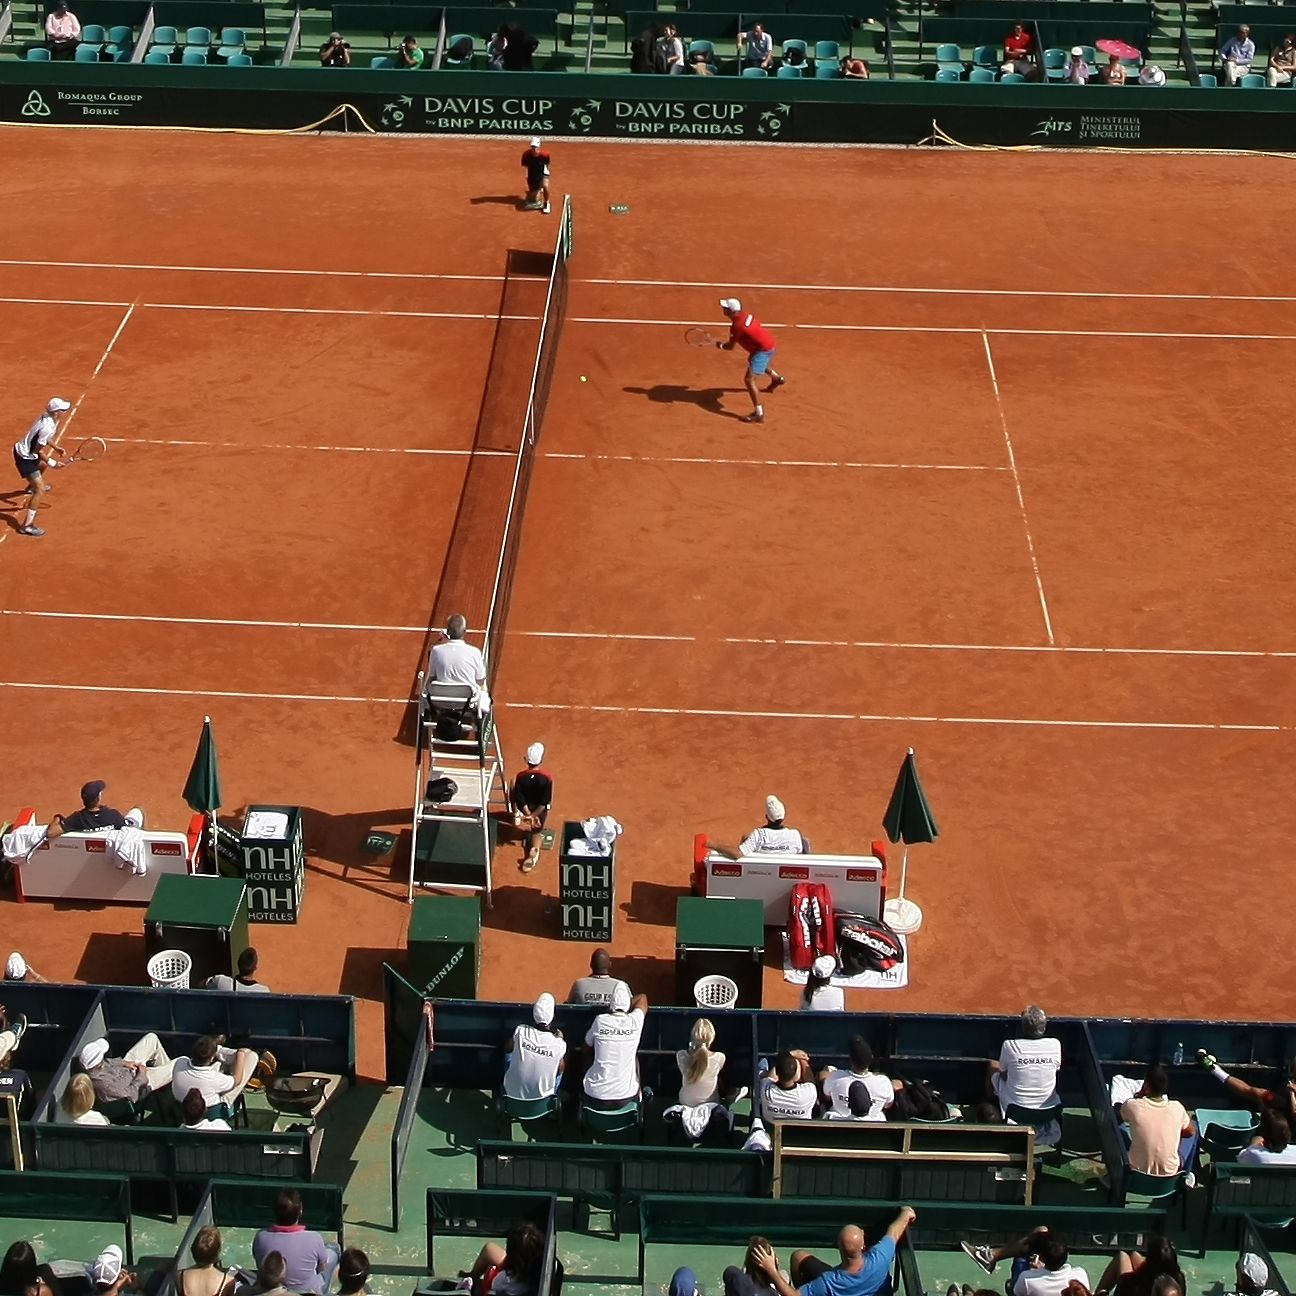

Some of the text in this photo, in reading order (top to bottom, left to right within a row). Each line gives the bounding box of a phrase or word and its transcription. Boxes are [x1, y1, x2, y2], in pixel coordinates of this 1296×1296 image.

[109, 92, 143, 102] GROUP
[424, 97, 553, 115] DAVIS CUP
[615, 101, 744, 120] DAVIS CUP
[425, 118, 554, 131] by BNP PARIBAS
[616, 122, 744, 135] by BNP PARIBAS
[245, 872, 292, 881] HOTELES
[563, 890, 609, 899] HOTELES
[248, 912, 294, 921] HOTELES
[563, 930, 609, 939] HOTELES
[426, 946, 465, 992] DUNLOP
[522, 1042, 554, 1058] ROMANIA
[1017, 1057, 1054, 1065] ROMANIA
[768, 1106, 806, 1116] ROMANIA
